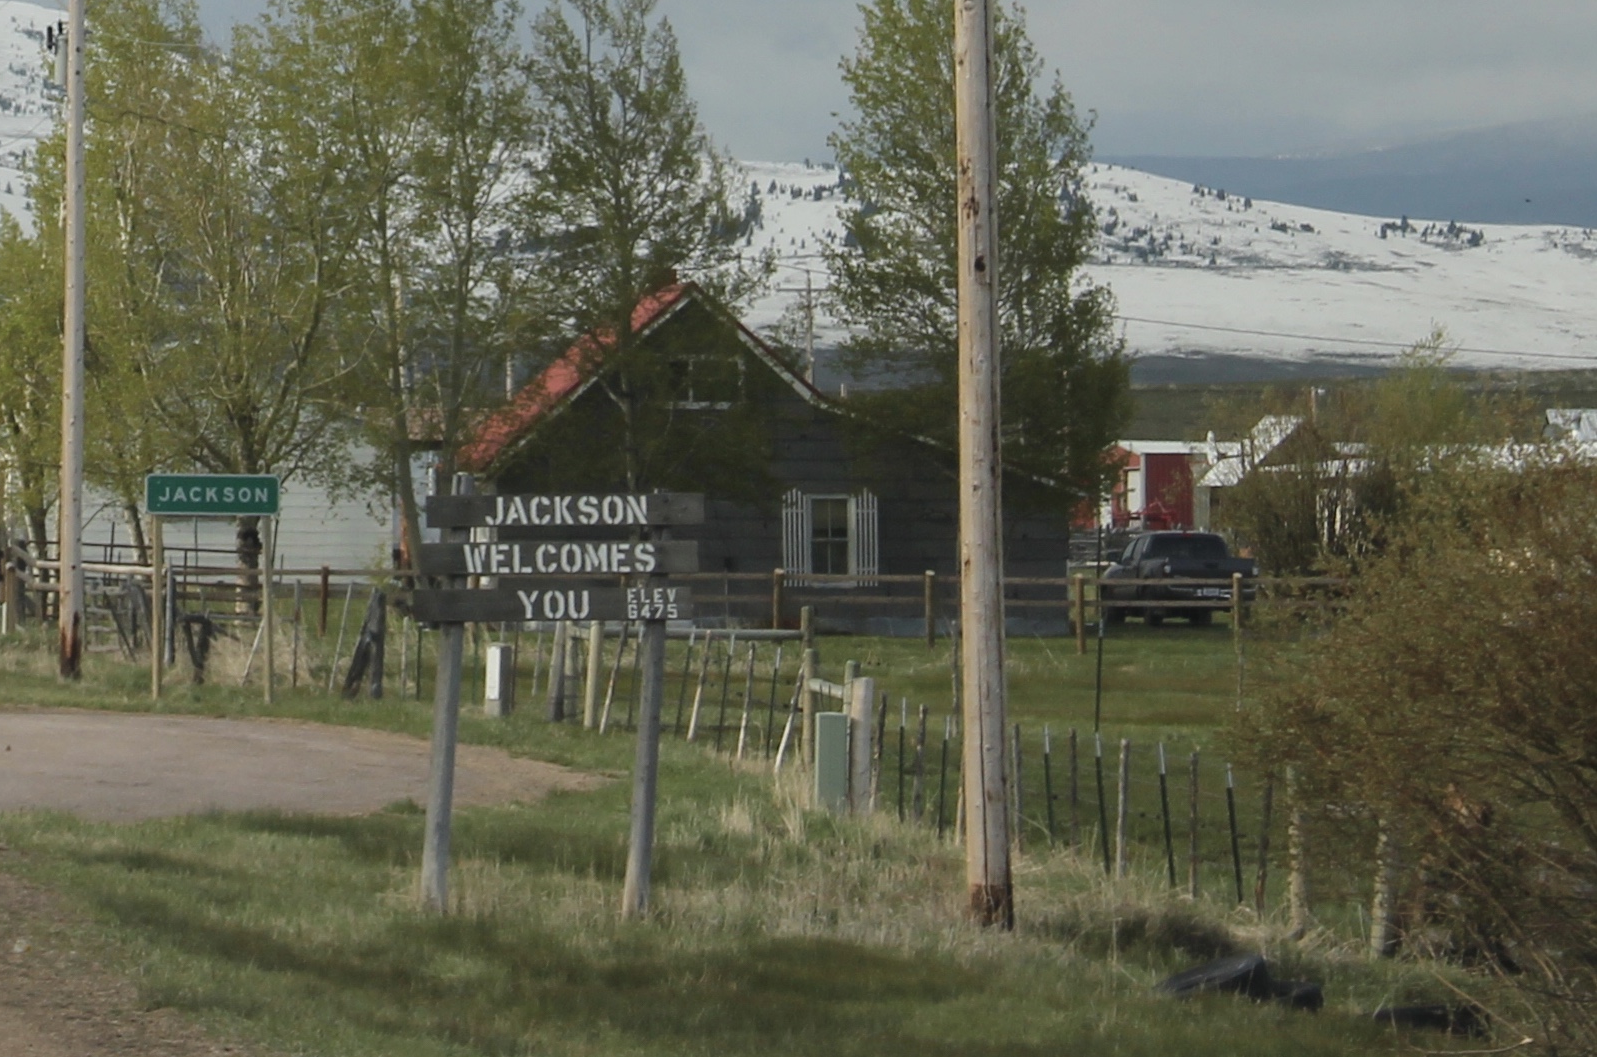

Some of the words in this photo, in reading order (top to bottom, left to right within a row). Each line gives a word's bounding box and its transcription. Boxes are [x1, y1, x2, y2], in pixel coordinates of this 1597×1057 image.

[158, 486, 269, 503] JACKSON
[485, 496, 648, 525] JACKSON
[463, 544, 656, 573] WELCOMES
[517, 590, 589, 619] YOU
[627, 588, 677, 603] ELEV
